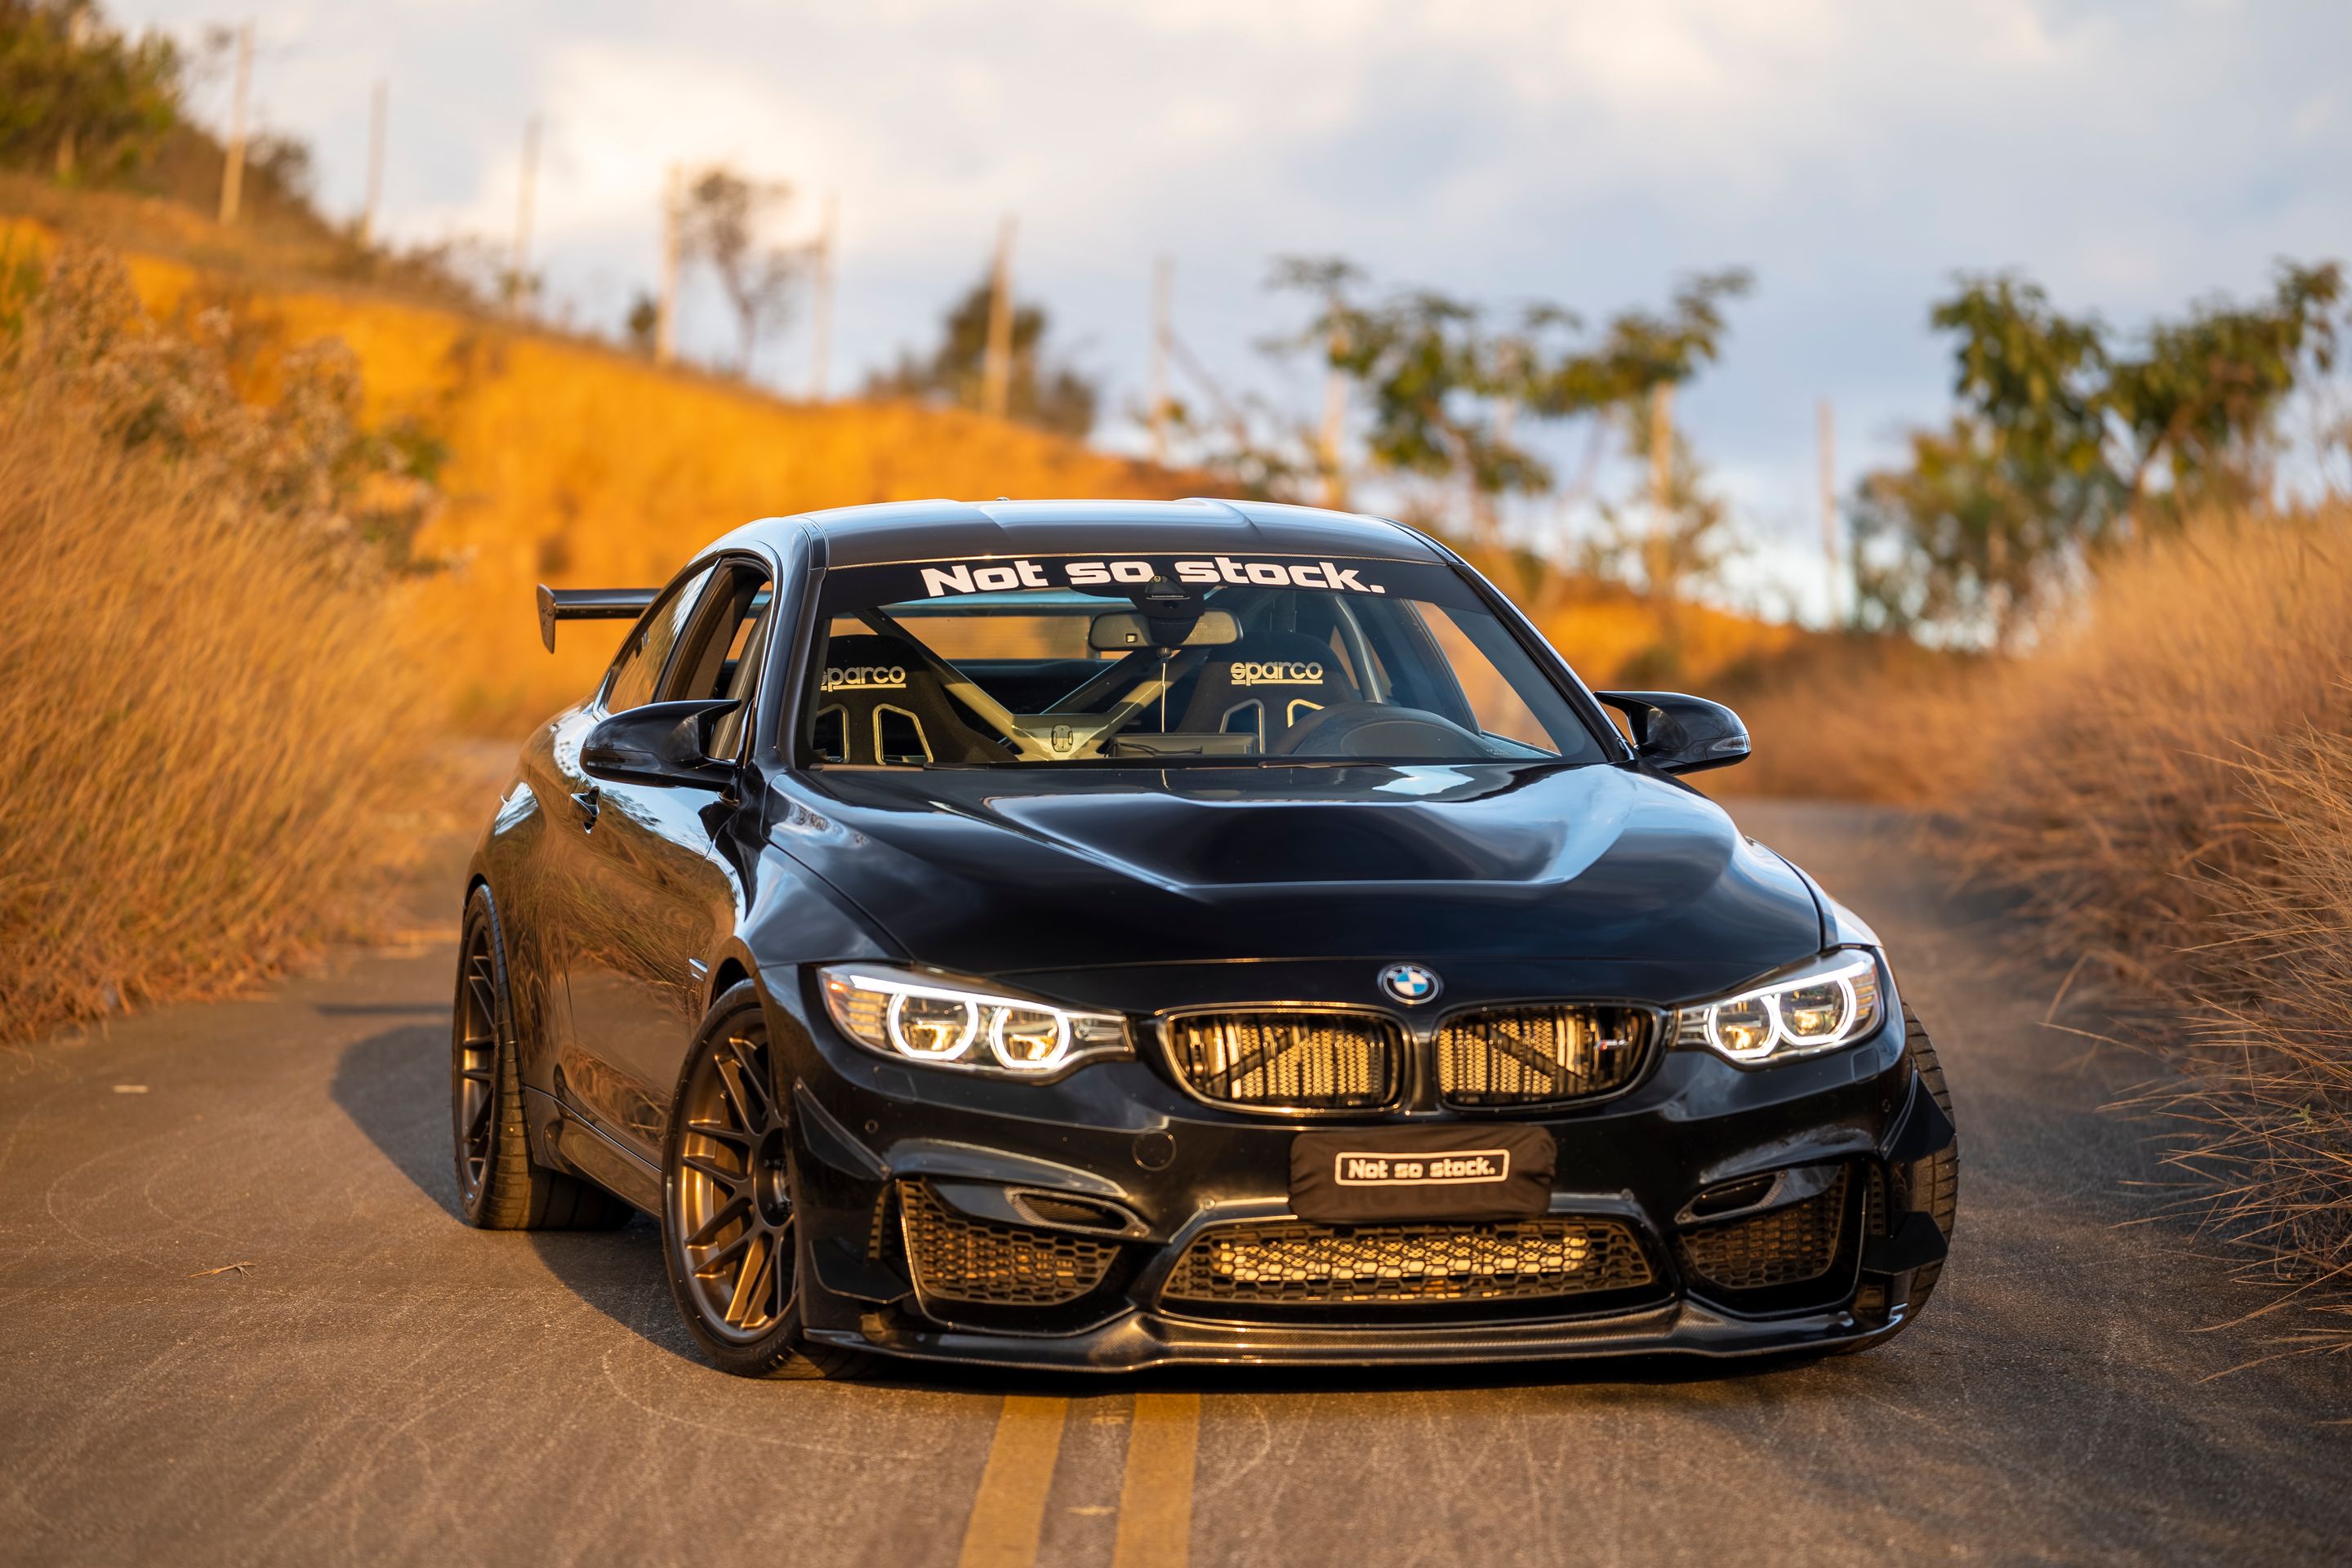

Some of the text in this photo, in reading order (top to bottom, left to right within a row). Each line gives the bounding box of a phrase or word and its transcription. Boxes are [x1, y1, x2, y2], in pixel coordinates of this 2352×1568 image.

[920, 557, 1386, 597] Not so stock.
[1231, 662, 1323, 686] sparco
[1348, 1156, 1496, 1179] Not so stock.
